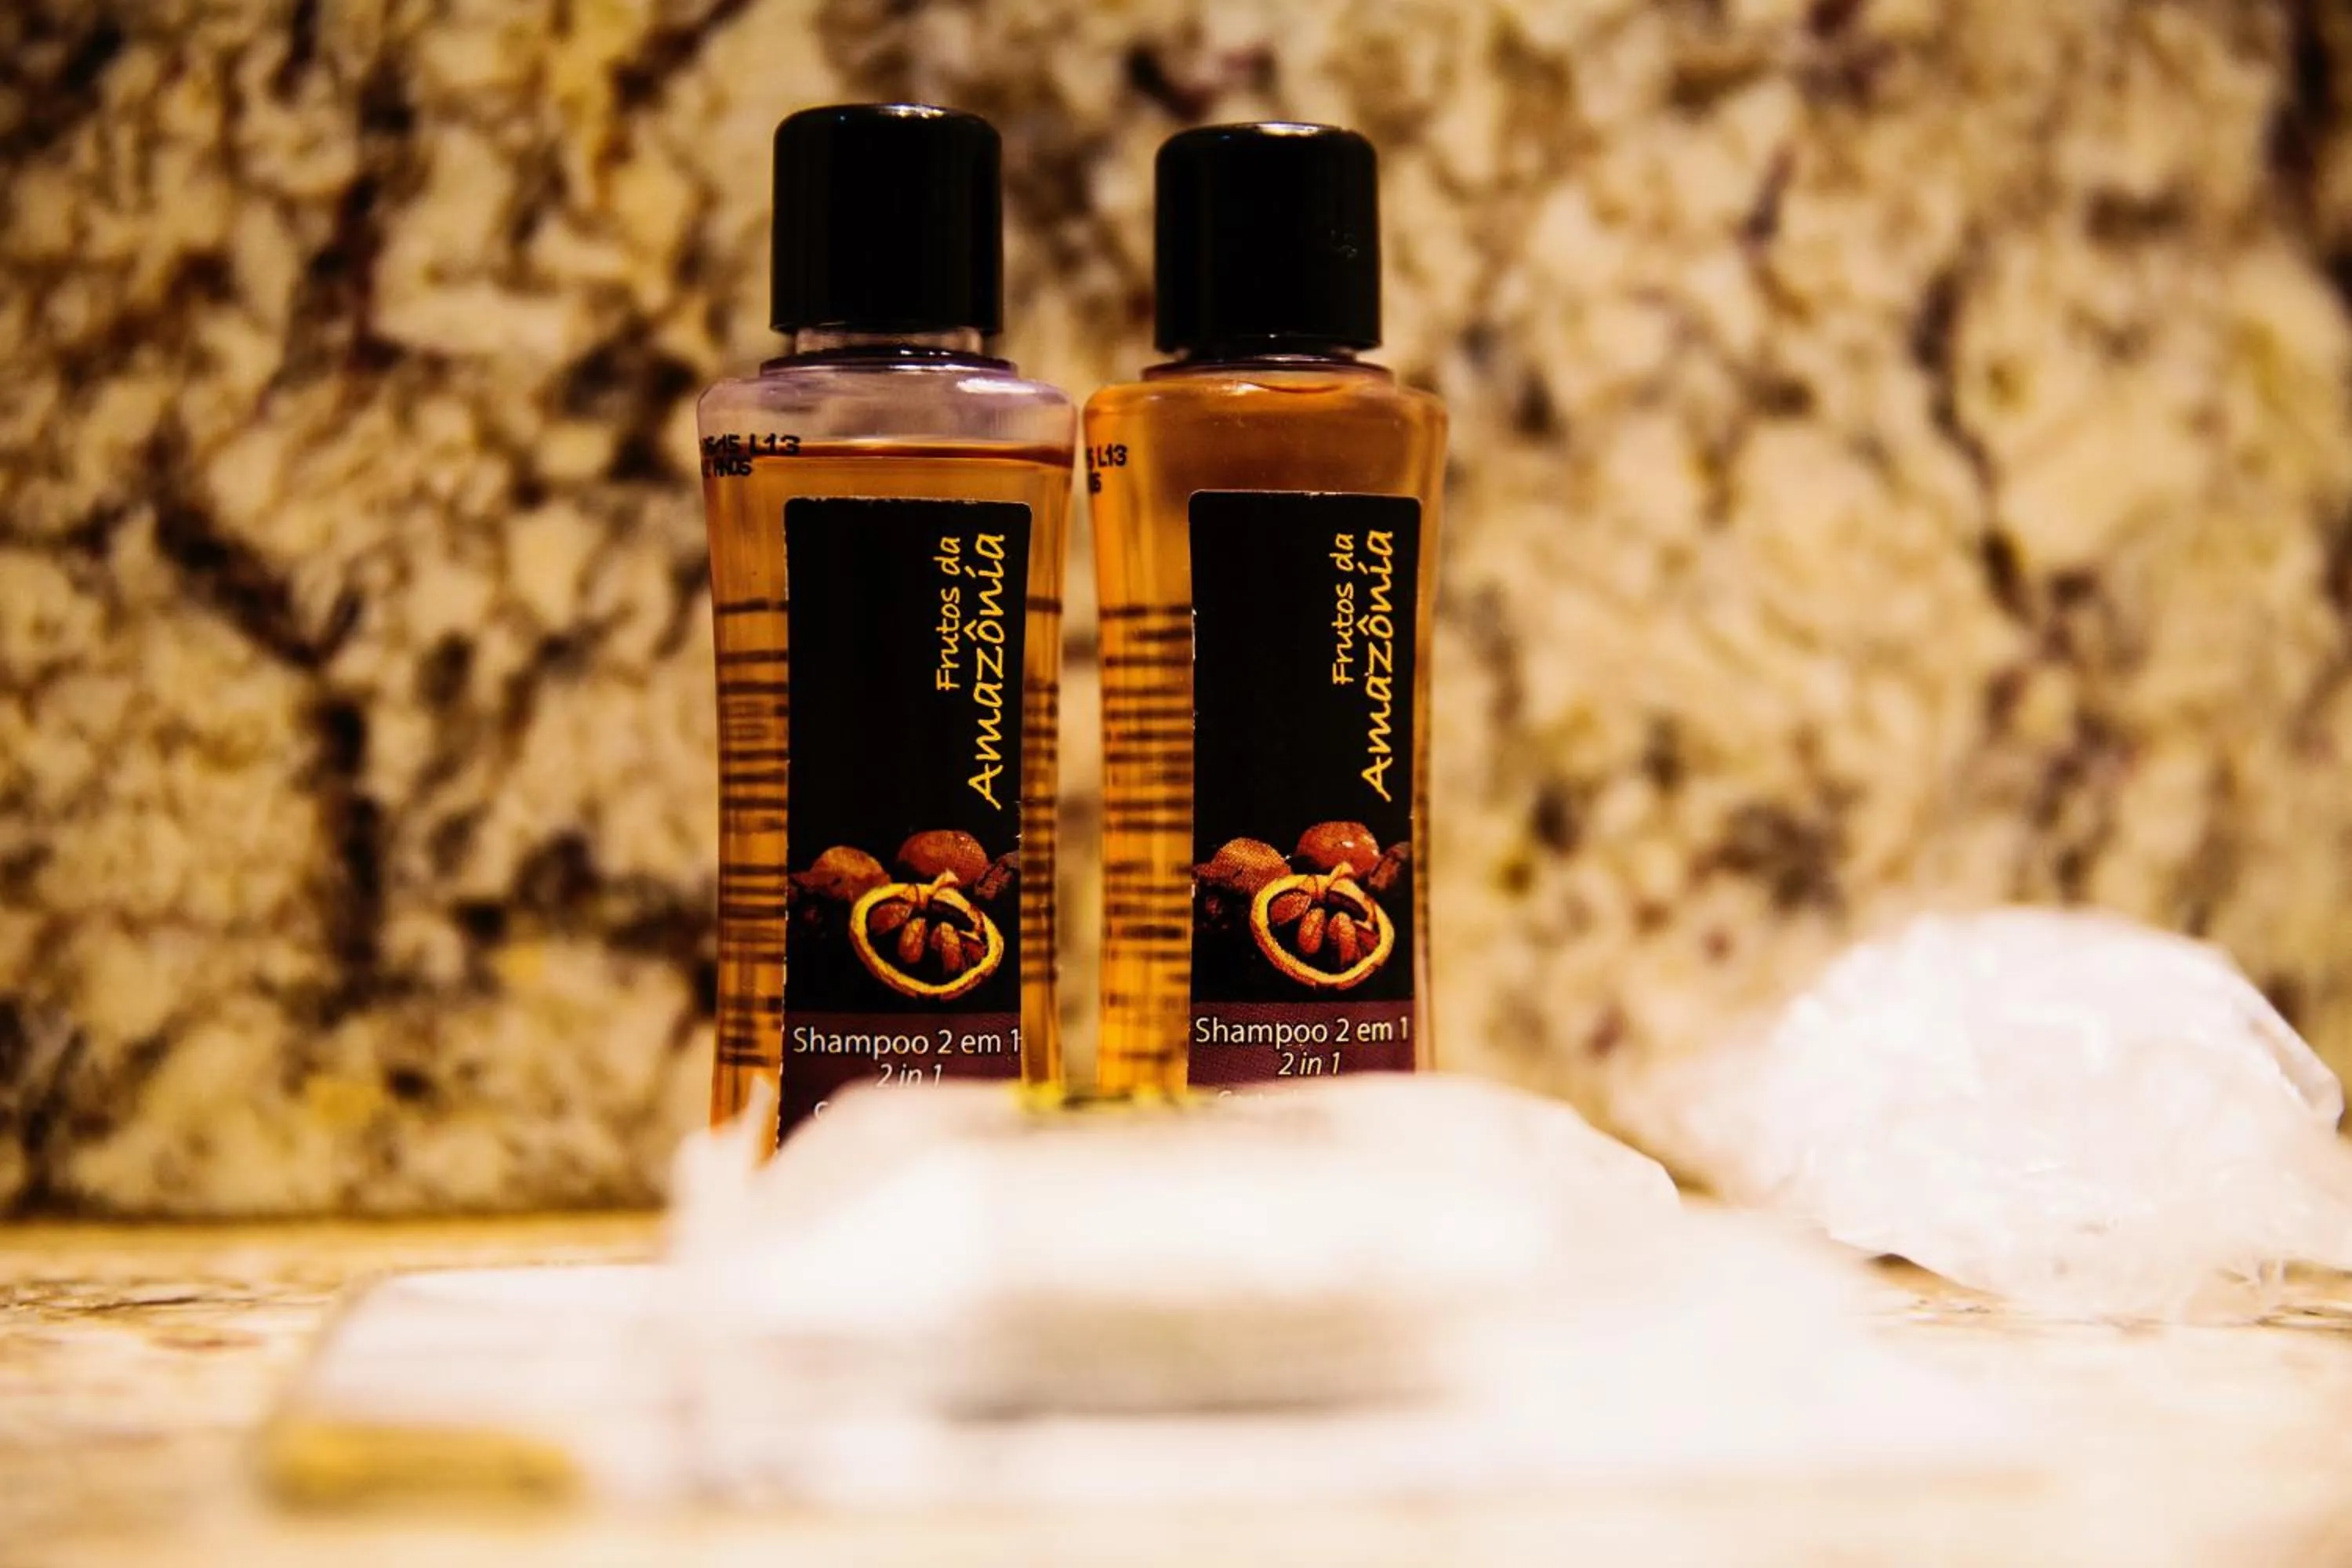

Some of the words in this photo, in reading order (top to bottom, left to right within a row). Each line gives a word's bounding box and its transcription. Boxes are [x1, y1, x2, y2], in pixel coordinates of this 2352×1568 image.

[749, 433, 800, 455] L13
[1097, 443, 1127, 467] L13
[933, 536, 961, 575] da
[1329, 533, 1356, 572] da
[935, 586, 961, 691] Frutos
[1331, 582, 1356, 685] Frutos
[793, 1026, 930, 1060] Shampoo
[937, 1029, 953, 1054] 2
[960, 1033, 1002, 1054] em
[1011, 1028, 1019, 1053] 1
[1195, 1016, 1328, 1050] Shampoo
[1335, 1018, 1350, 1043] 2
[1356, 1022, 1392, 1041] em
[1400, 1016, 1409, 1040] 1
[875, 1063, 893, 1088] 2
[898, 1063, 923, 1088] in
[933, 1063, 942, 1088] 1
[1277, 1051, 1294, 1076] 2
[1298, 1051, 1323, 1076] in
[1331, 1051, 1341, 1076] 1
